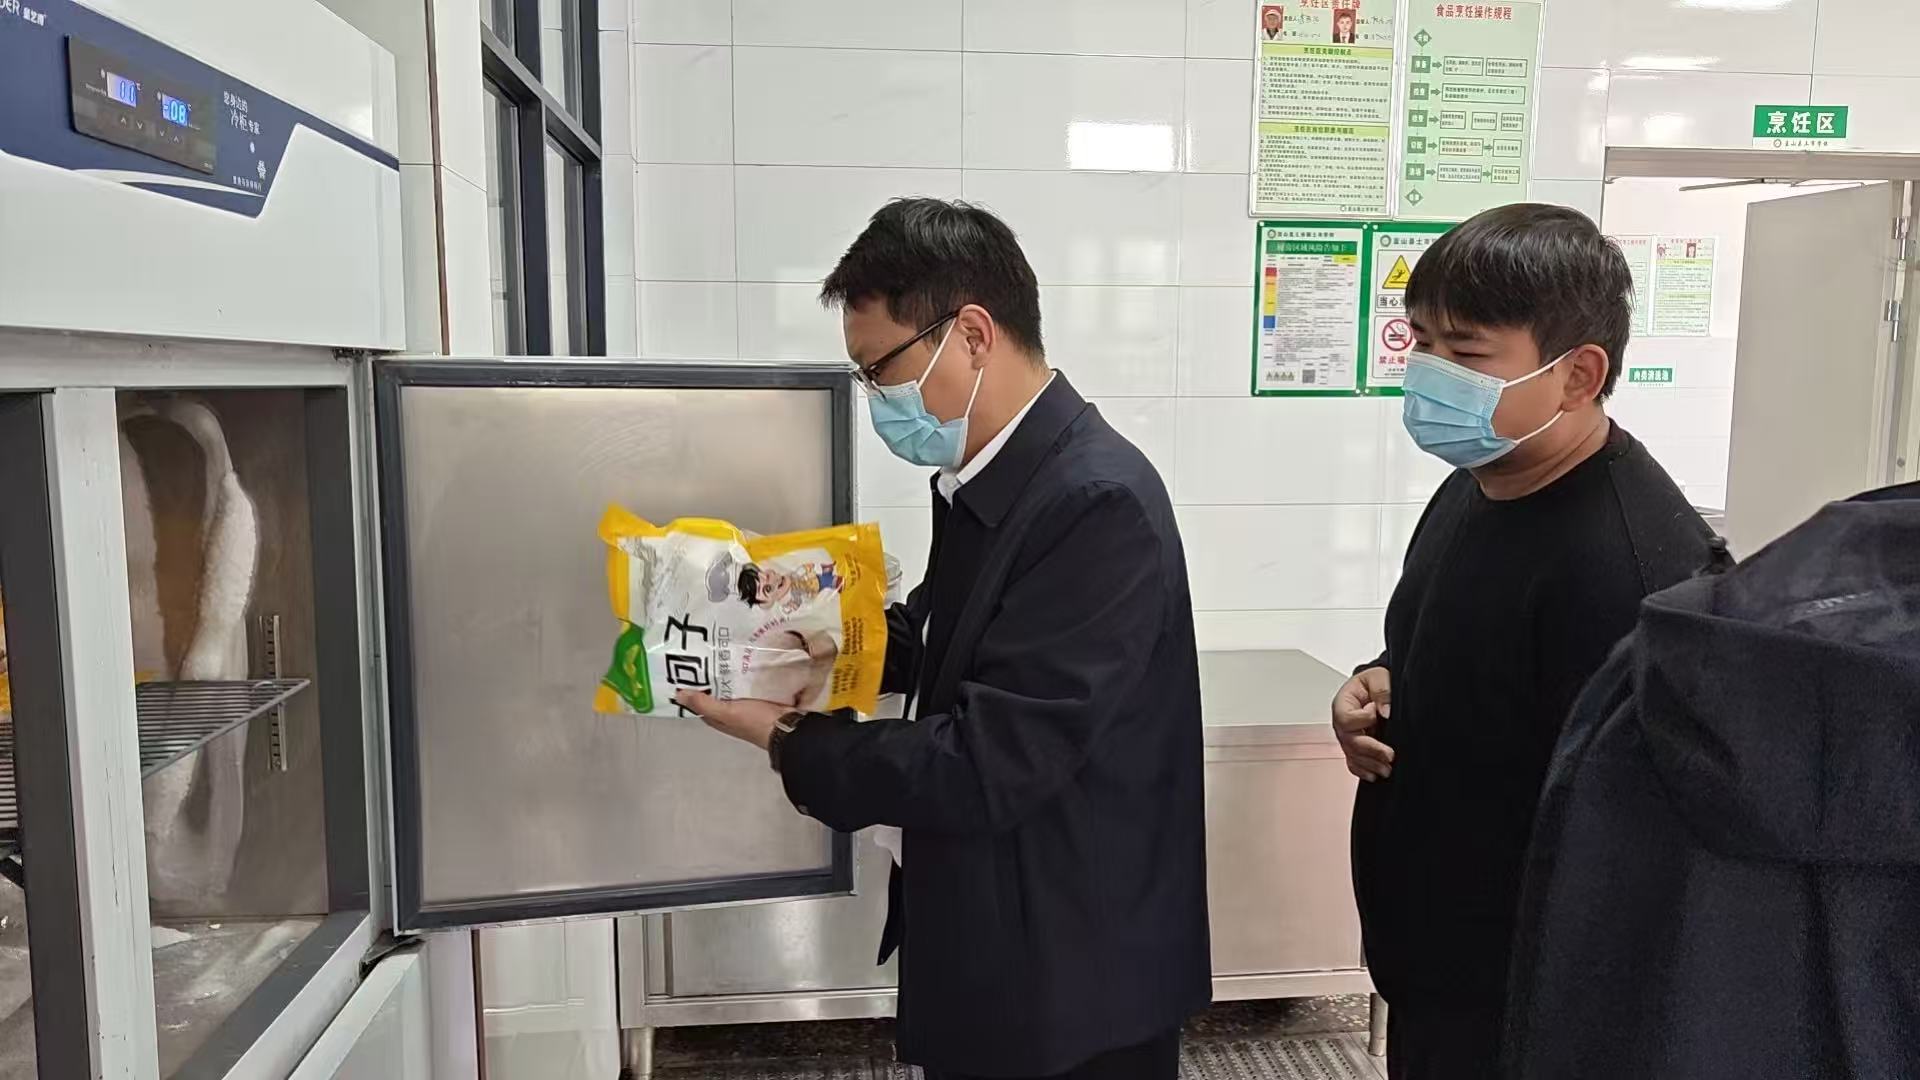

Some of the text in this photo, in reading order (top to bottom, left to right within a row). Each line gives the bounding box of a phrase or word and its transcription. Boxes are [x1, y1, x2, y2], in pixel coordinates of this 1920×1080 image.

[1436, 3, 1512, 20] 食品烹饪操作规程
[1766, 111, 1835, 134] 烹饪区
[1380, 296, 1406, 307] 当心
